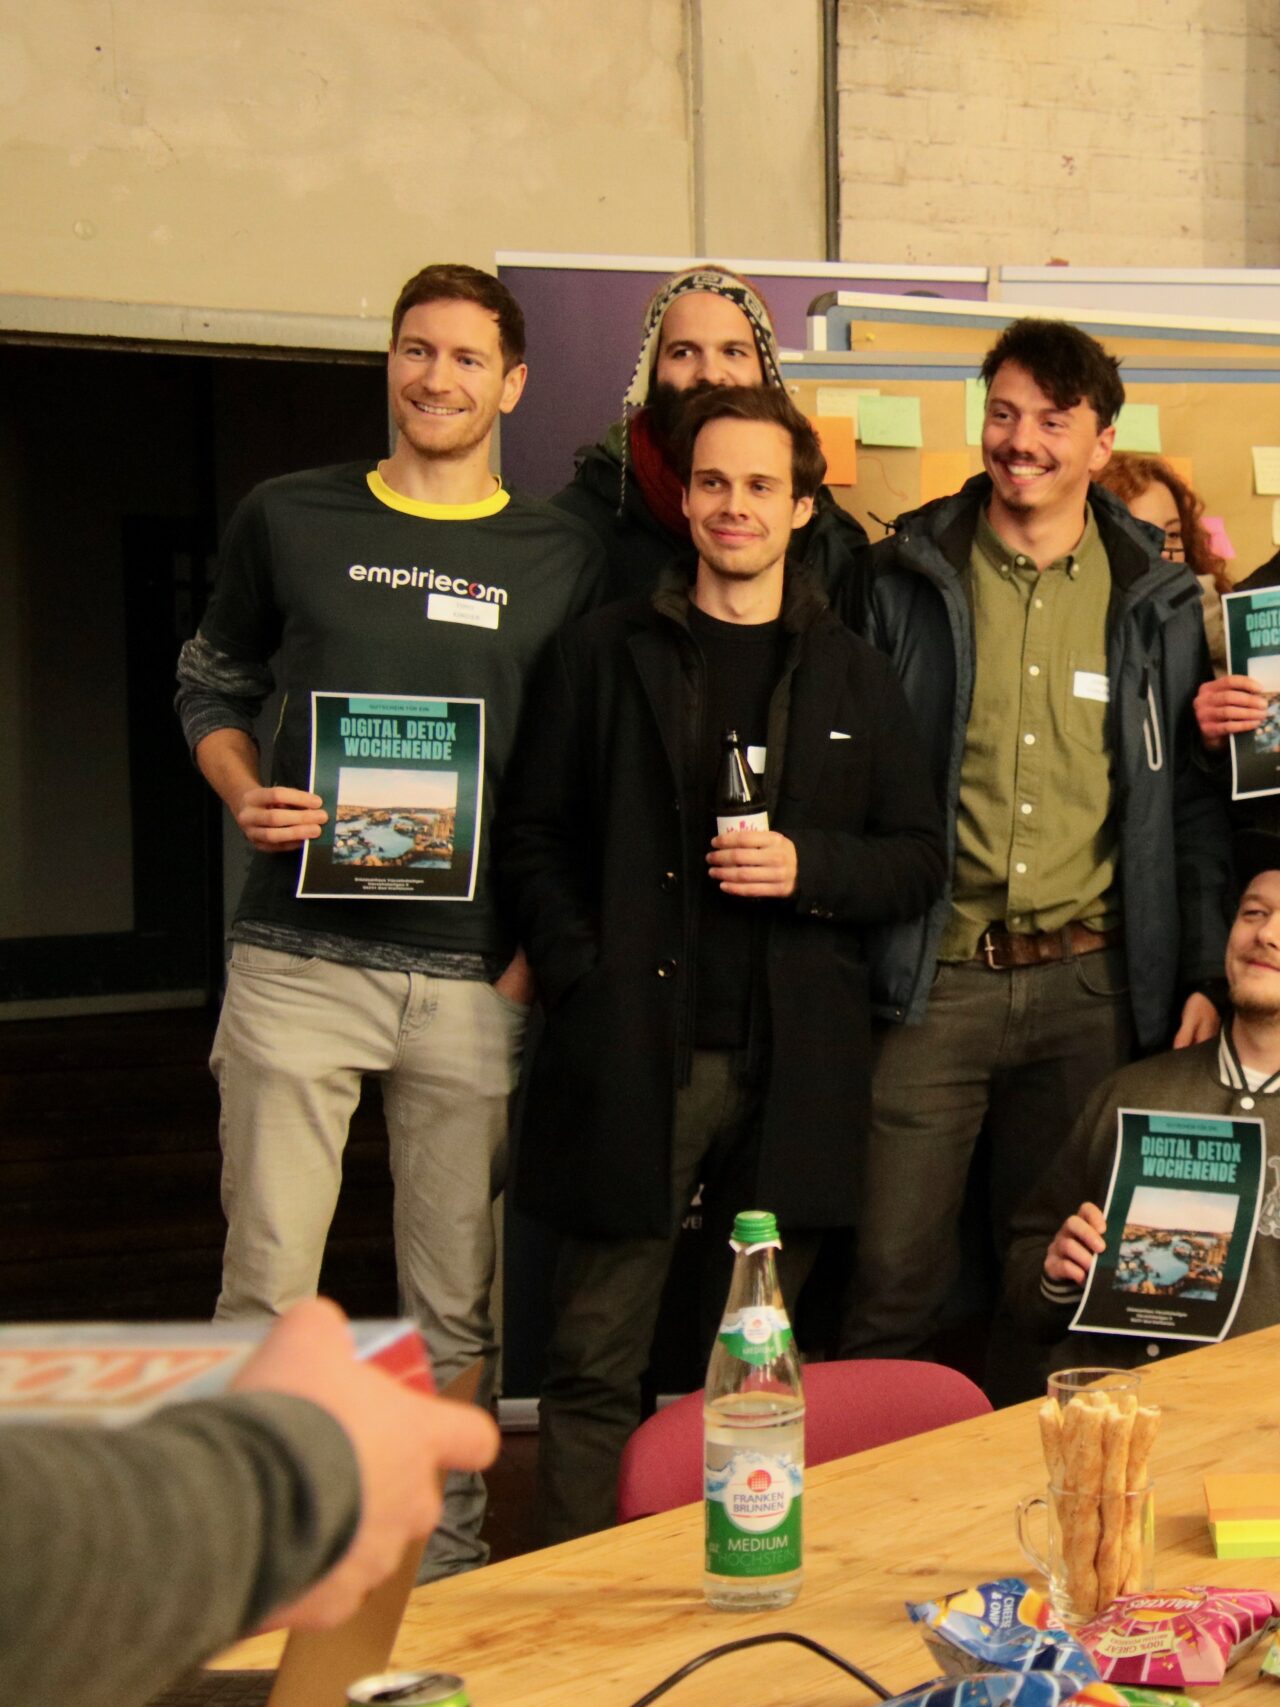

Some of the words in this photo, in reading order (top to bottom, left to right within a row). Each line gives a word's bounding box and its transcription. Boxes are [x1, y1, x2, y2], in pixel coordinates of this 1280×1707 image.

[349, 564, 508, 605] empiriecom
[340, 717, 401, 738] DIGITAL
[406, 720, 457, 741] DETOX
[344, 737, 453, 761] WOCHENENDE
[1140, 1135, 1193, 1159] DIGITAL
[1197, 1140, 1242, 1163] DETOX
[1142, 1156, 1238, 1184] WOCHENENDE
[733, 1491, 785, 1504] FRANKEN
[733, 1502, 784, 1514] BRUNNEN
[727, 1535, 789, 1553] MEDIUM
